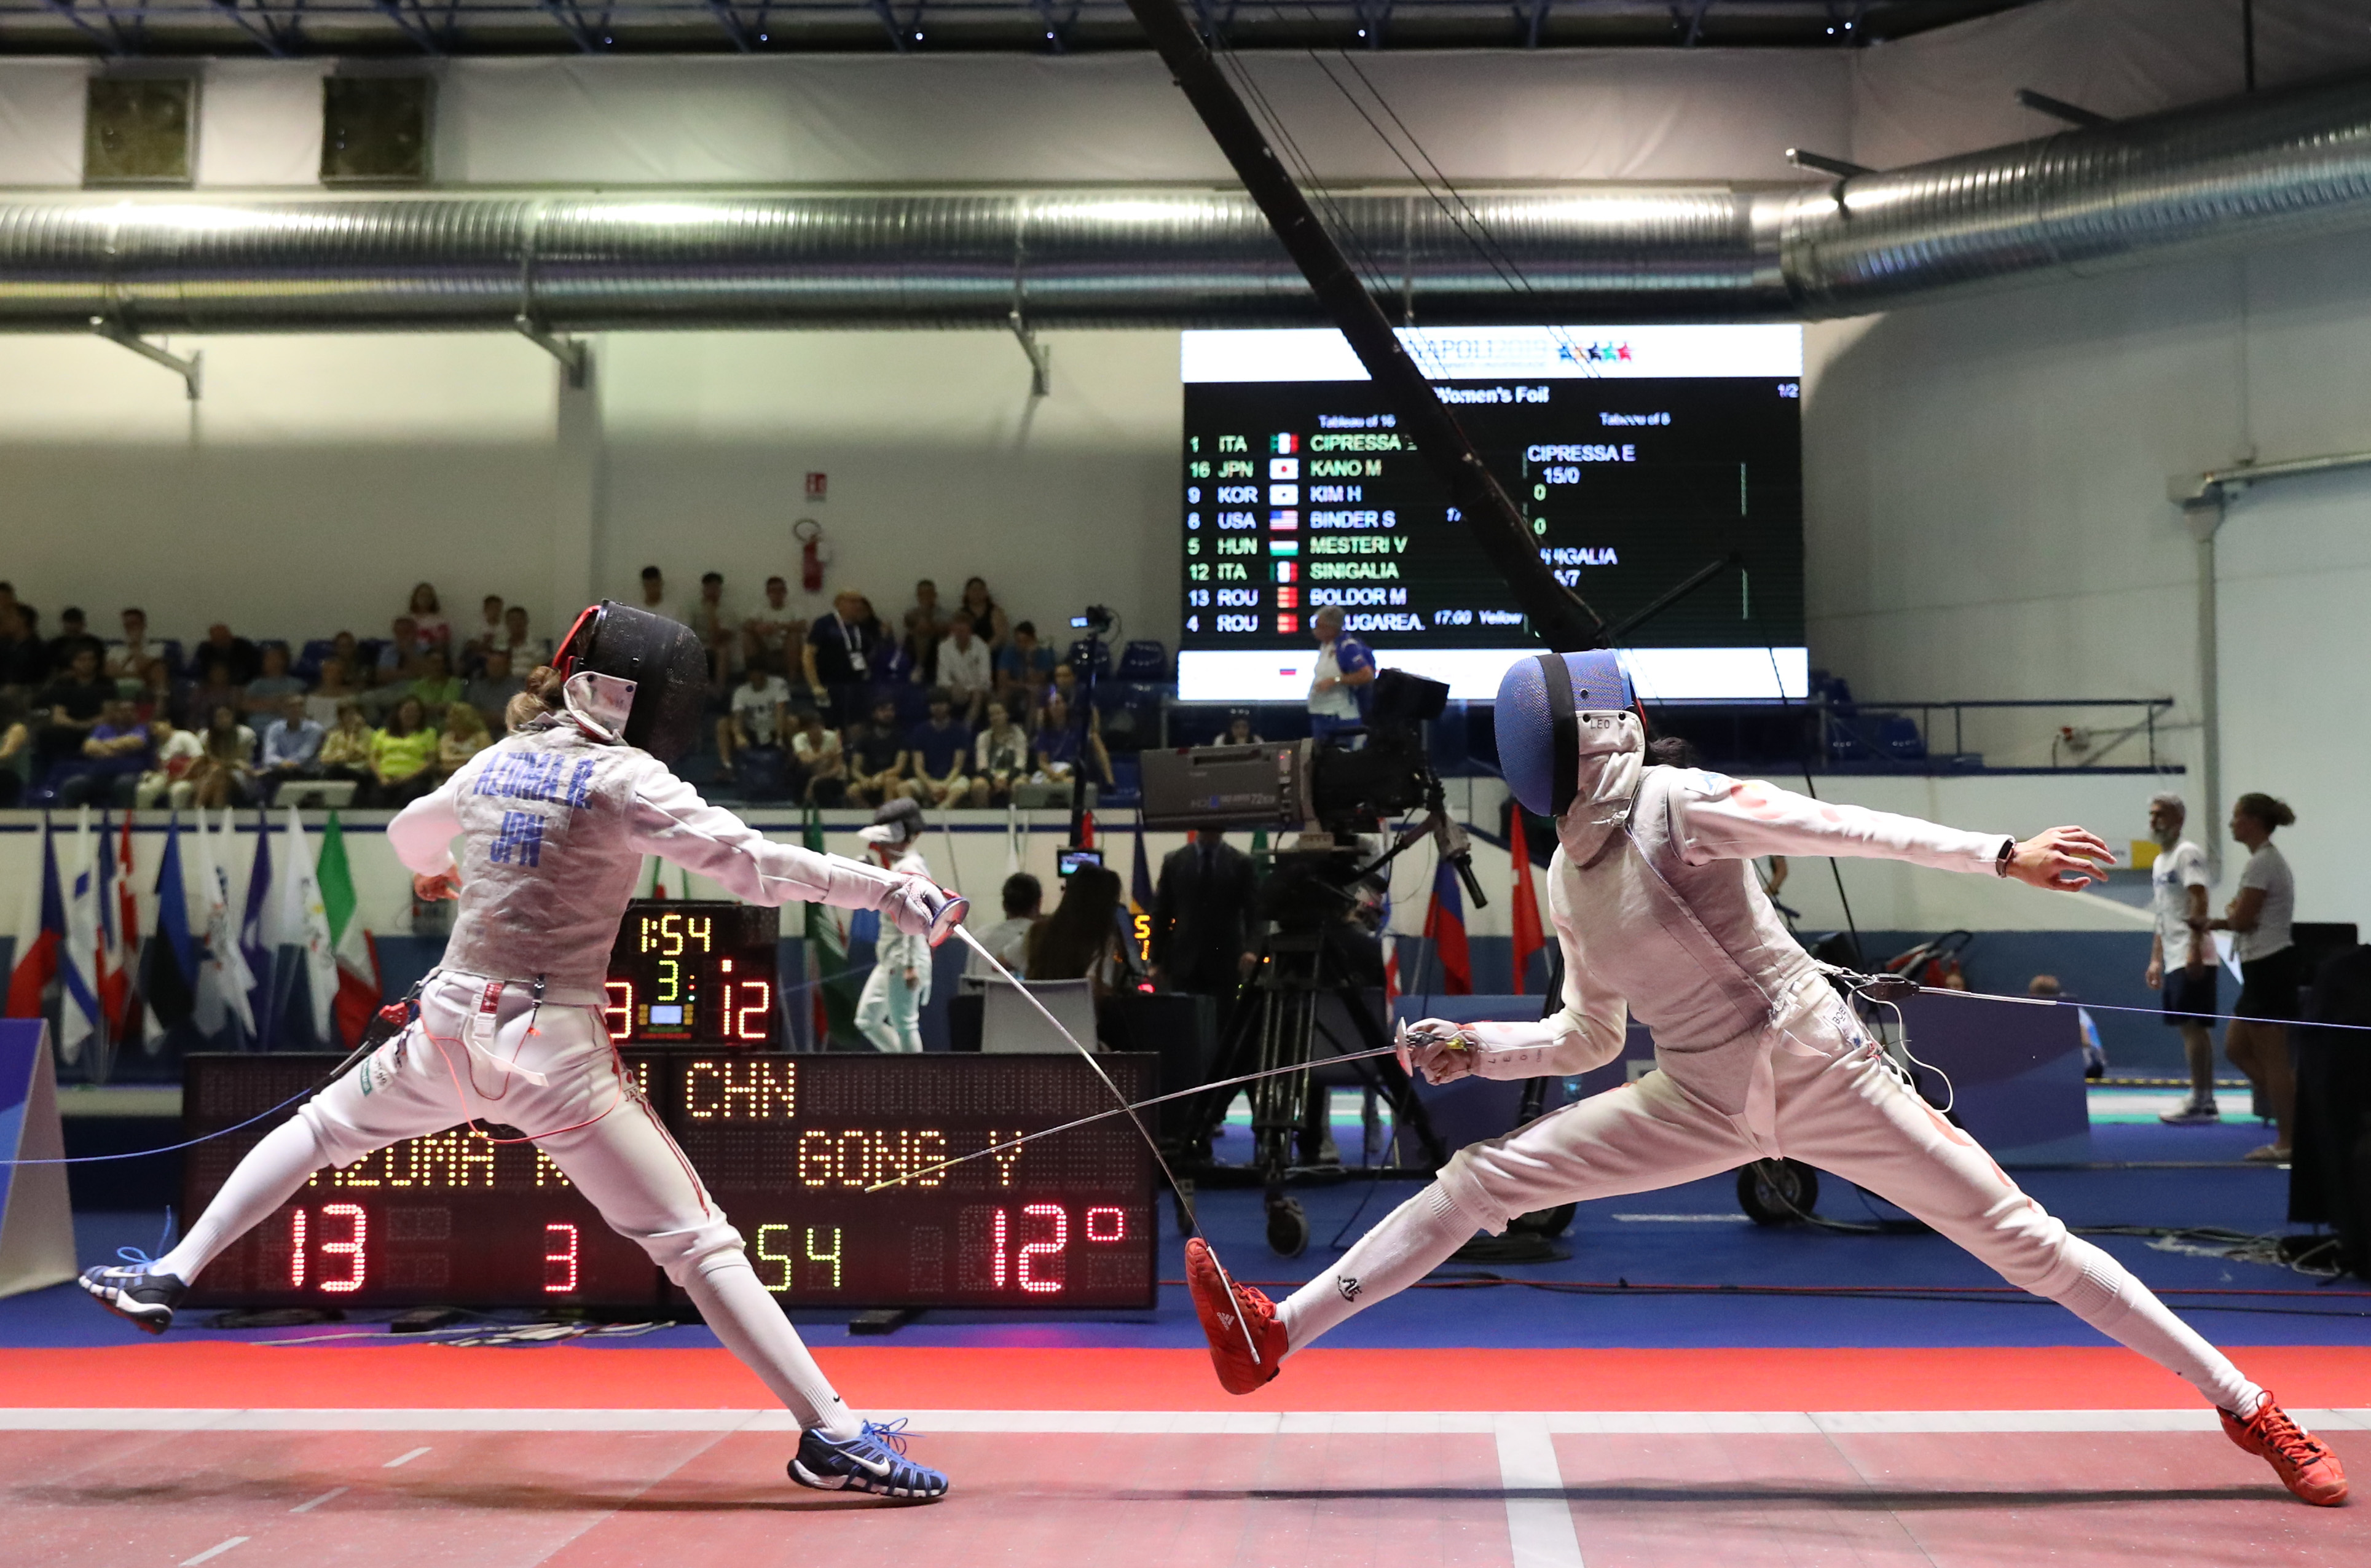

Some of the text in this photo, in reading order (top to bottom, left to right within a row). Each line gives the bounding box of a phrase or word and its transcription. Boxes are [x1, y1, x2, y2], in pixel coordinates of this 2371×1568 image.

[1515, 386, 1549, 402] Foil
[1190, 436, 1199, 453] 1
[1219, 436, 1248, 453] ITA
[1310, 434, 1401, 452] CIPRESSA
[1527, 444, 1637, 461] CIPRESSA E
[1190, 460, 1382, 478] 16 JPN KANO M
[1543, 466, 1580, 484] 15/0
[1187, 485, 1362, 504] 9 KOR KIM H
[1533, 484, 1546, 501] 0
[1217, 512, 1256, 529] USA
[1310, 511, 1379, 528] BINDER
[1382, 511, 1396, 528] S
[1533, 517, 1547, 535] 0
[1188, 536, 1408, 555] 5 HUN MESTERI V
[1189, 562, 1399, 581] 12 ITA SINIGALIA
[1189, 587, 1407, 606] 13 ROU BOLDOR M
[1186, 615, 1199, 632] 4
[1217, 614, 1259, 632] ROU
[1478, 610, 1524, 625] Yellow
[1590, 719, 1610, 729] LEO
[640, 915, 711, 955] 1:54
[658, 960, 679, 1002] 3
[723, 981, 769, 1038] 12
[685, 1062, 796, 1118] CHN
[798, 1131, 1023, 1186] GONG Y
[291, 1203, 368, 1293] 13
[543, 1223, 578, 1292] 3
